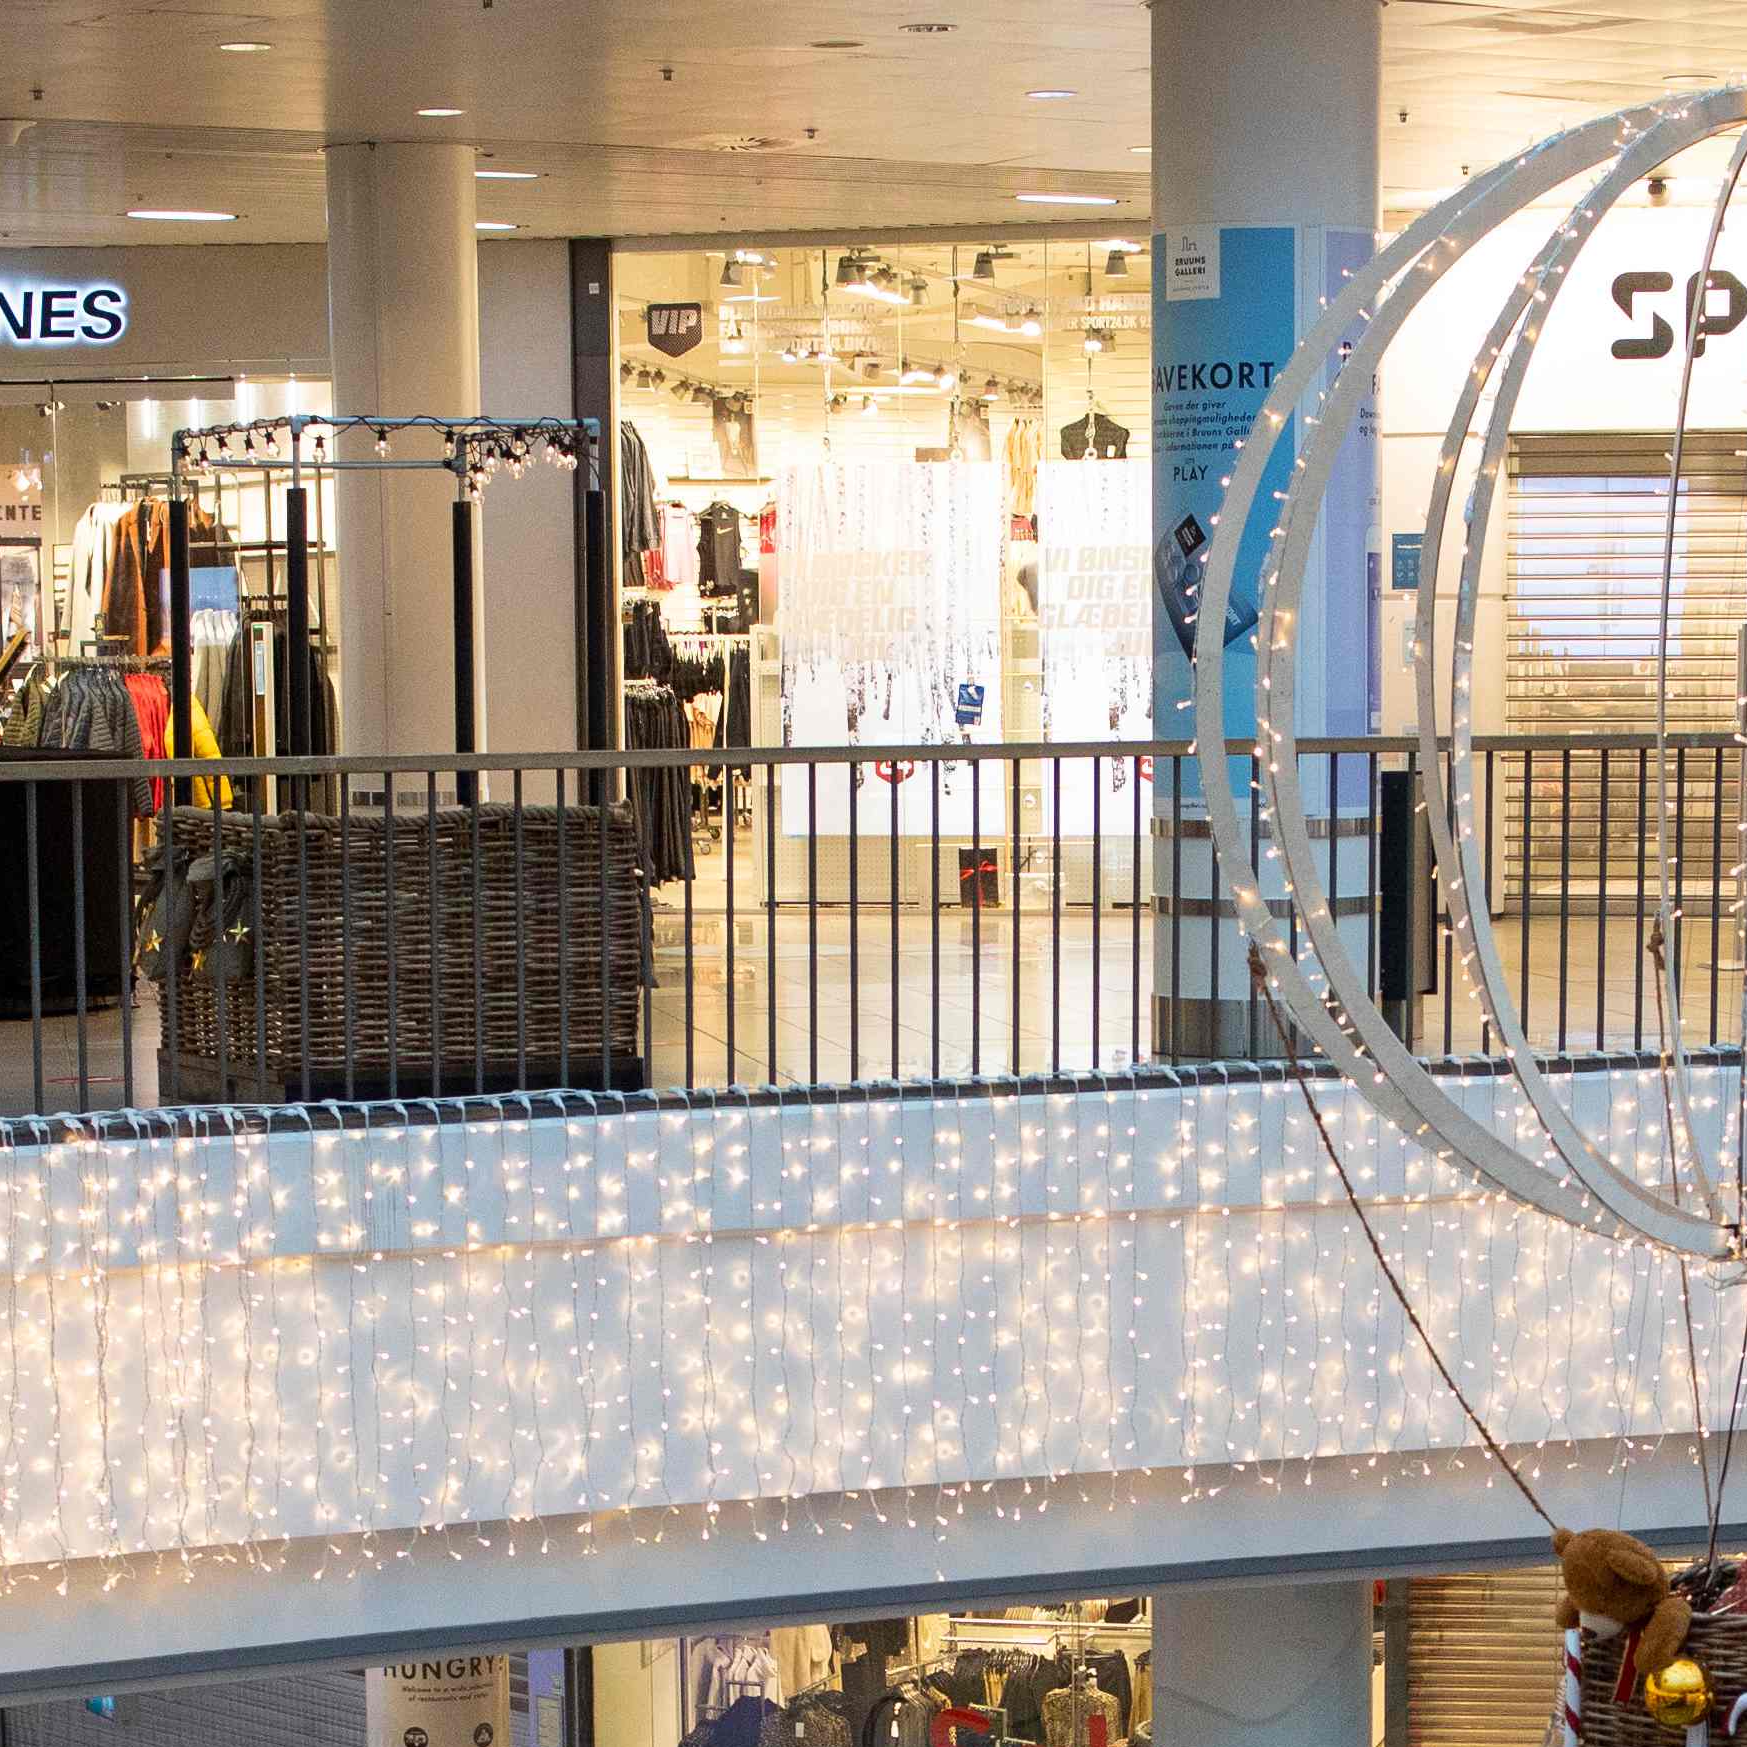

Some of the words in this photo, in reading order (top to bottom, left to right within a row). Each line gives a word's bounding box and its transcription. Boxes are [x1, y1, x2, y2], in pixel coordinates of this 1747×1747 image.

[1174, 256, 1206, 265] BRUUNS
[651, 309, 700, 336] VIP
[1152, 361, 1275, 394] AVEKORT
[1173, 465, 1210, 481] PLAY
